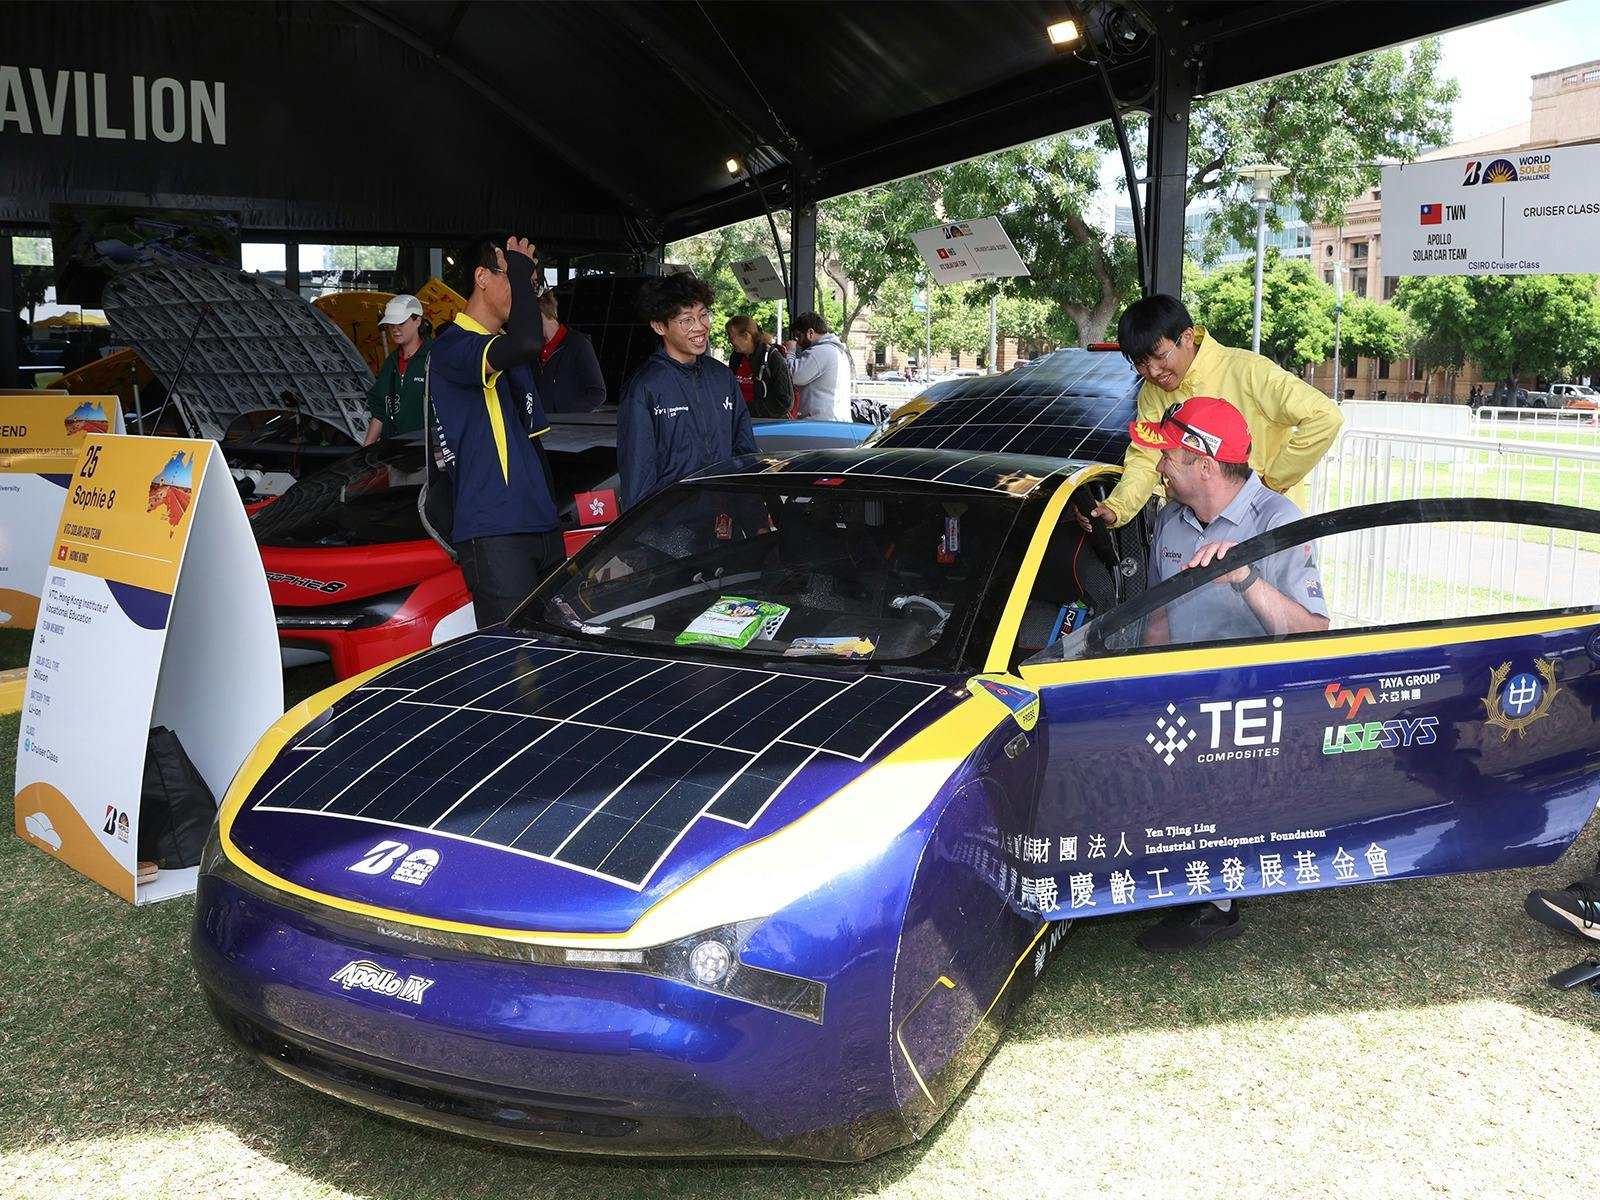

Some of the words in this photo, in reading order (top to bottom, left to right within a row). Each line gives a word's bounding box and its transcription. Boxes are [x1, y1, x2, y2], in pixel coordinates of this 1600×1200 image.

[1519, 155, 1551, 165] WORLD
[1519, 165, 1551, 175] SOLAR
[1519, 174, 1550, 182] CHALLENGE
[1446, 205, 1466, 221] TWN
[1523, 206, 1565, 217] CRUISER
[1567, 204, 1600, 215] CLASS
[1427, 233, 1452, 246] APOLLO
[1412, 249, 1433, 261] SOLAR
[1434, 249, 1447, 261] CAR
[1448, 248, 1467, 260] TEAM
[1468, 261, 1490, 270] CSIRO
[1491, 261, 1518, 270] Cruiser
[1519, 260, 1540, 269] Class
[0, 425, 27, 437] END
[80, 445, 102, 478] 25
[73, 485, 106, 510] Sophie
[107, 489, 116, 509] 8
[1379, 677, 1404, 689] TAYA
[1405, 673, 1441, 687] GROUP
[1323, 717, 1440, 755] USESYS
[1197, 747, 1280, 763] COMPOSITES
[1145, 828, 1164, 839] Yen
[1165, 825, 1192, 838] Tjing
[1194, 823, 1217, 836] Ling
[1145, 840, 1196, 854] Industrial
[1199, 834, 1265, 849] Development
[1270, 828, 1327, 842] Foundation
[329, 960, 403, 995] Apollo
[397, 975, 435, 1004] IX
